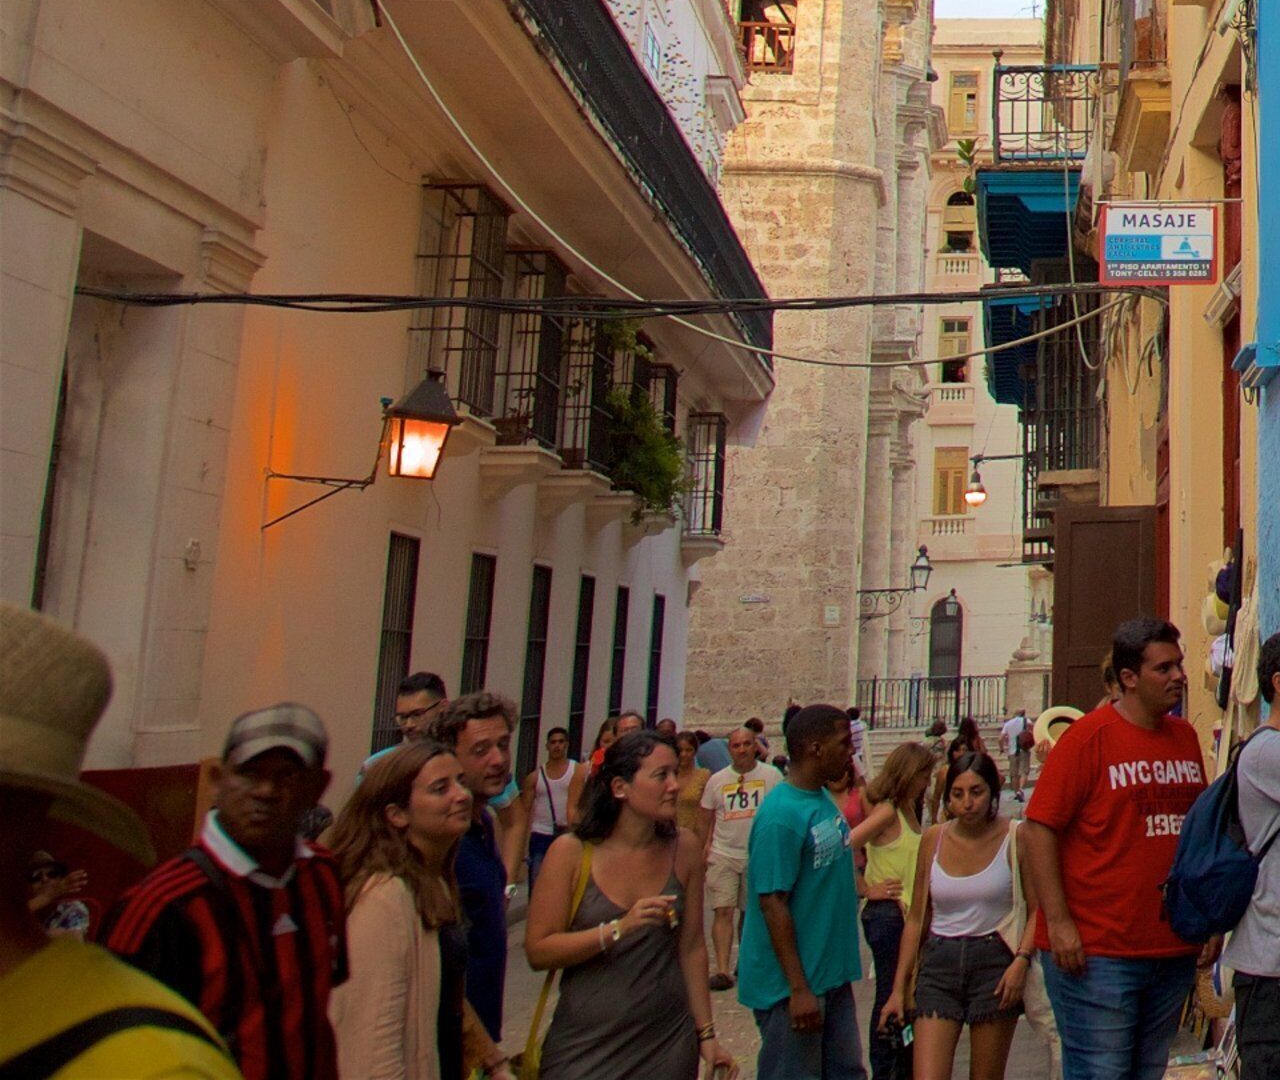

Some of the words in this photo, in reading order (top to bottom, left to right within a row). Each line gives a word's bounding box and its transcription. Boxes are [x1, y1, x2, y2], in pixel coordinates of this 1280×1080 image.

[1122, 213, 1197, 228] MASAJE
[1119, 263, 1139, 271] PISO
[1140, 263, 1200, 271] APARTAMENTO
[1107, 759, 1152, 791] NYC
[727, 789, 760, 811] 781
[1145, 813, 1187, 838] 198
